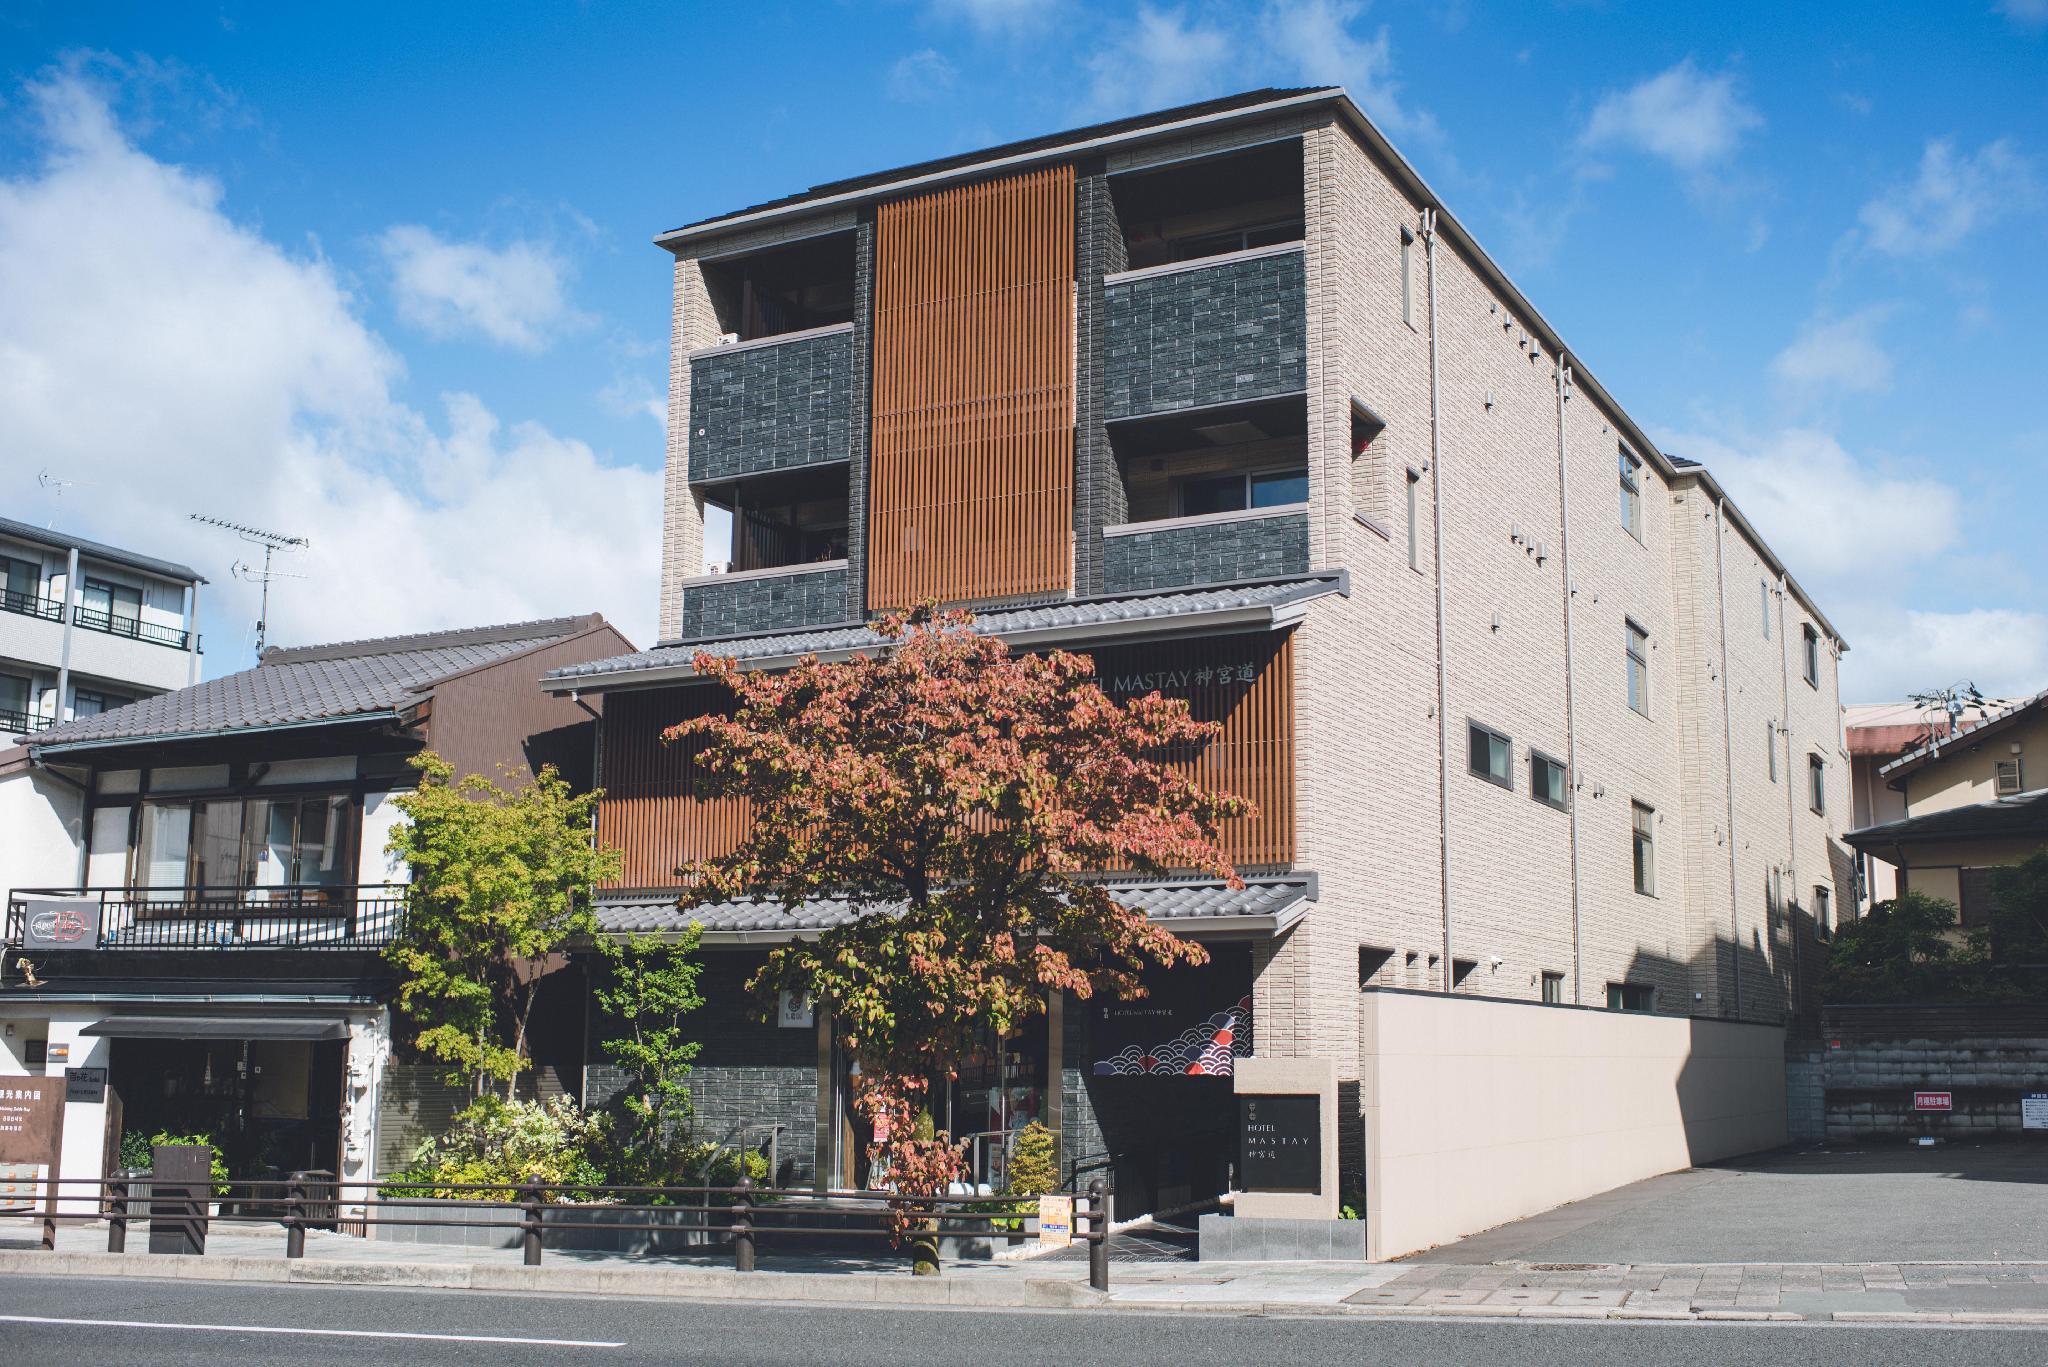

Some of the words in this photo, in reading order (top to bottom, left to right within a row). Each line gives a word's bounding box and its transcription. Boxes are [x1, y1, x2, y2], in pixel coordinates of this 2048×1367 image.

[1114, 670, 1192, 693] MASTAY
[1194, 661, 1256, 687] 神宮道
[1247, 1124, 1276, 1132] HOTEL
